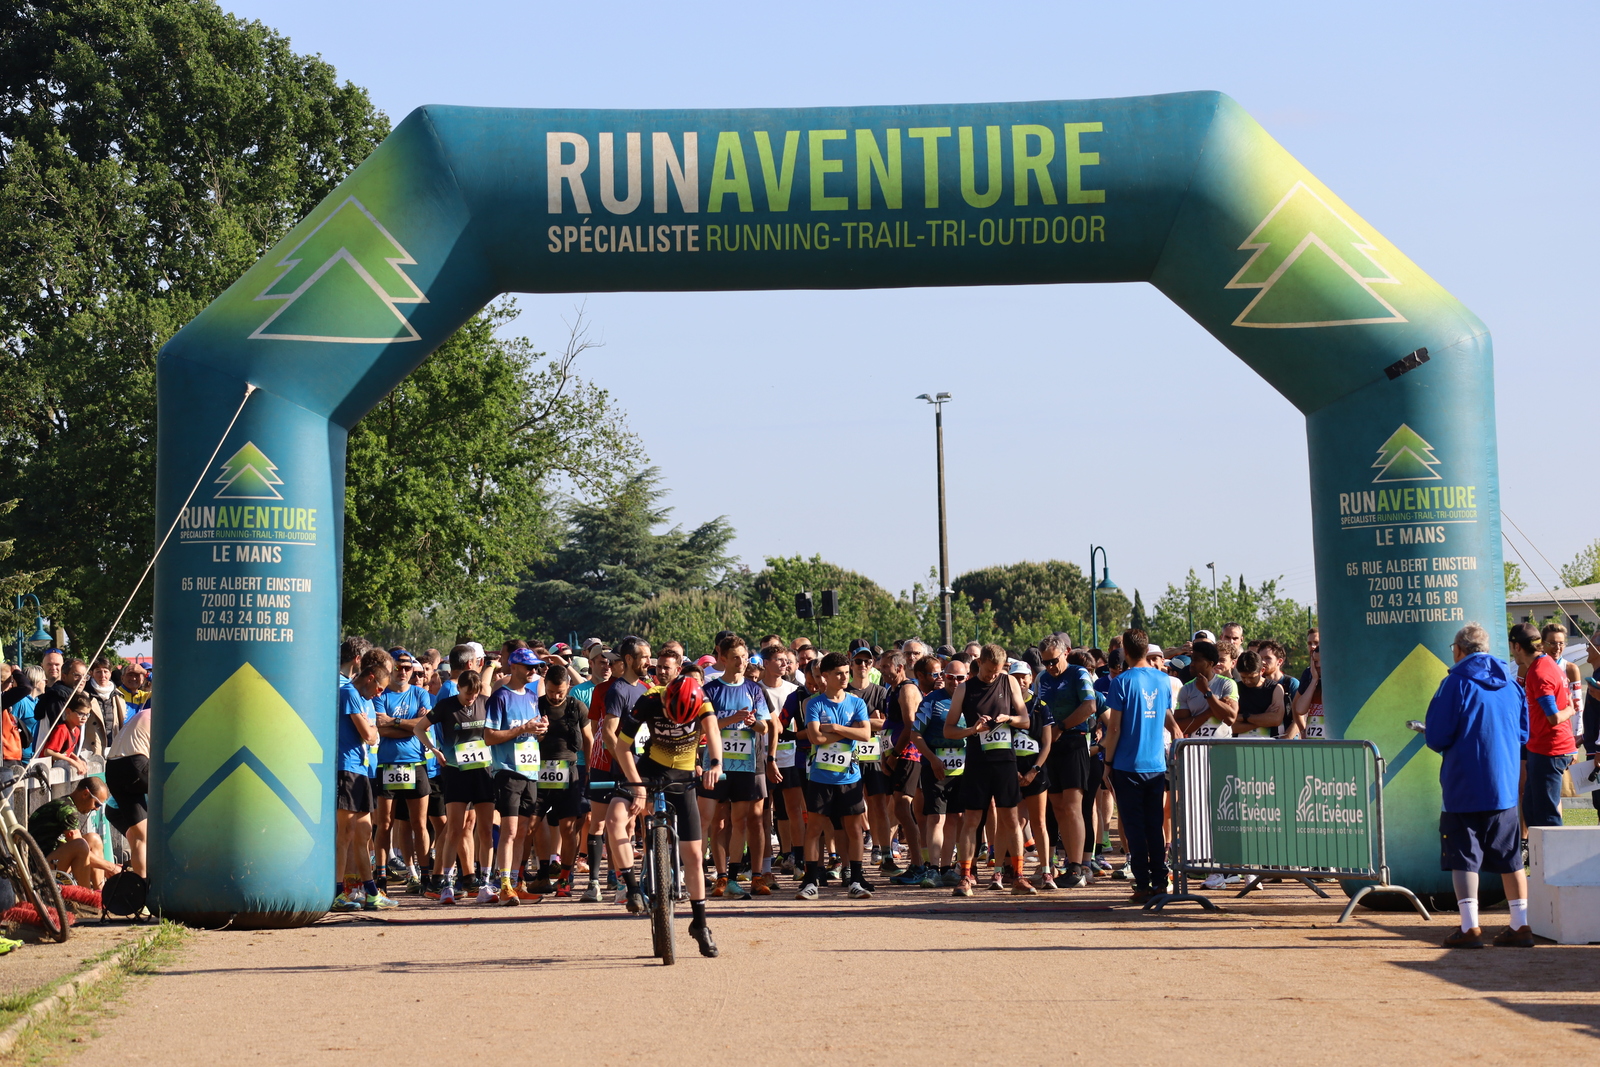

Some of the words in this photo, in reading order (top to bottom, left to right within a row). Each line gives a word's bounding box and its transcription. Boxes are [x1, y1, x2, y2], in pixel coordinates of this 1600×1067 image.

[546, 122, 1106, 214] RUNAVENTURE
[548, 218, 700, 253] SPÉCIALISTE
[706, 215, 1106, 252] RUNNING-TRAIL-TRI-OUTDOOR
[1339, 486, 1477, 515] RUNAVENTURE
[180, 505, 317, 531] RUNAVENTURE
[1341, 513, 1376, 525] SPÉCIALISTE
[1377, 510, 1477, 522] RUNNING-TRAIL-TRI-OUTDOOR
[180, 528, 215, 539] SPÉCIALISTE
[216, 530, 317, 541] RUNNING-TRAIL-TRI-OUTDOOR
[1376, 528, 1394, 546] LE
[1400, 525, 1446, 545] MANS
[212, 545, 230, 562] LE
[236, 545, 282, 563] MANS
[1346, 562, 1359, 576] 65
[1362, 560, 1383, 575] RUE
[1386, 558, 1428, 573] ALBERT
[1432, 556, 1477, 571] EINSTEIN
[181, 577, 193, 591] 65
[196, 577, 217, 590] RUE
[220, 577, 262, 591] ALBERT
[266, 577, 312, 592] EINSTEIN
[1368, 576, 1403, 591] 72000
[1407, 575, 1421, 589] LE
[1424, 574, 1458, 588] MANS
[201, 593, 235, 607] 72000
[240, 593, 253, 607] LE
[256, 594, 291, 608] MANS
[1370, 594, 1384, 608] 02
[1388, 593, 1403, 607] 43
[1407, 592, 1422, 606] 24
[1426, 591, 1440, 605] 05
[1444, 590, 1458, 605] 89
[202, 610, 215, 624] 02
[219, 610, 233, 624] 43
[238, 610, 253, 625] 24
[256, 611, 271, 625] 05
[275, 611, 289, 625] 89
[1366, 607, 1464, 625] RUNAVENTURE.FR
[196, 627, 294, 642] RUNAVENTURE.FR
[655, 721, 696, 736] MSV
[1195, 727, 1217, 737] 427
[723, 741, 747, 752] 317
[1013, 739, 1034, 750] 412
[462, 751, 485, 763] 311
[520, 753, 537, 764] 324
[821, 752, 846, 765] 319
[388, 773, 410, 783] 368
[540, 771, 564, 781] 460
[1234, 775, 1275, 799] Parigné
[1314, 776, 1357, 800] Parigné
[1235, 798, 1281, 825] l'Évêque
[1315, 799, 1364, 827] l'Évêque
[1217, 825, 1253, 833] accompagne
[1296, 827, 1334, 836] accompagne
[1336, 827, 1352, 835] votre
[1354, 827, 1364, 835] vie
